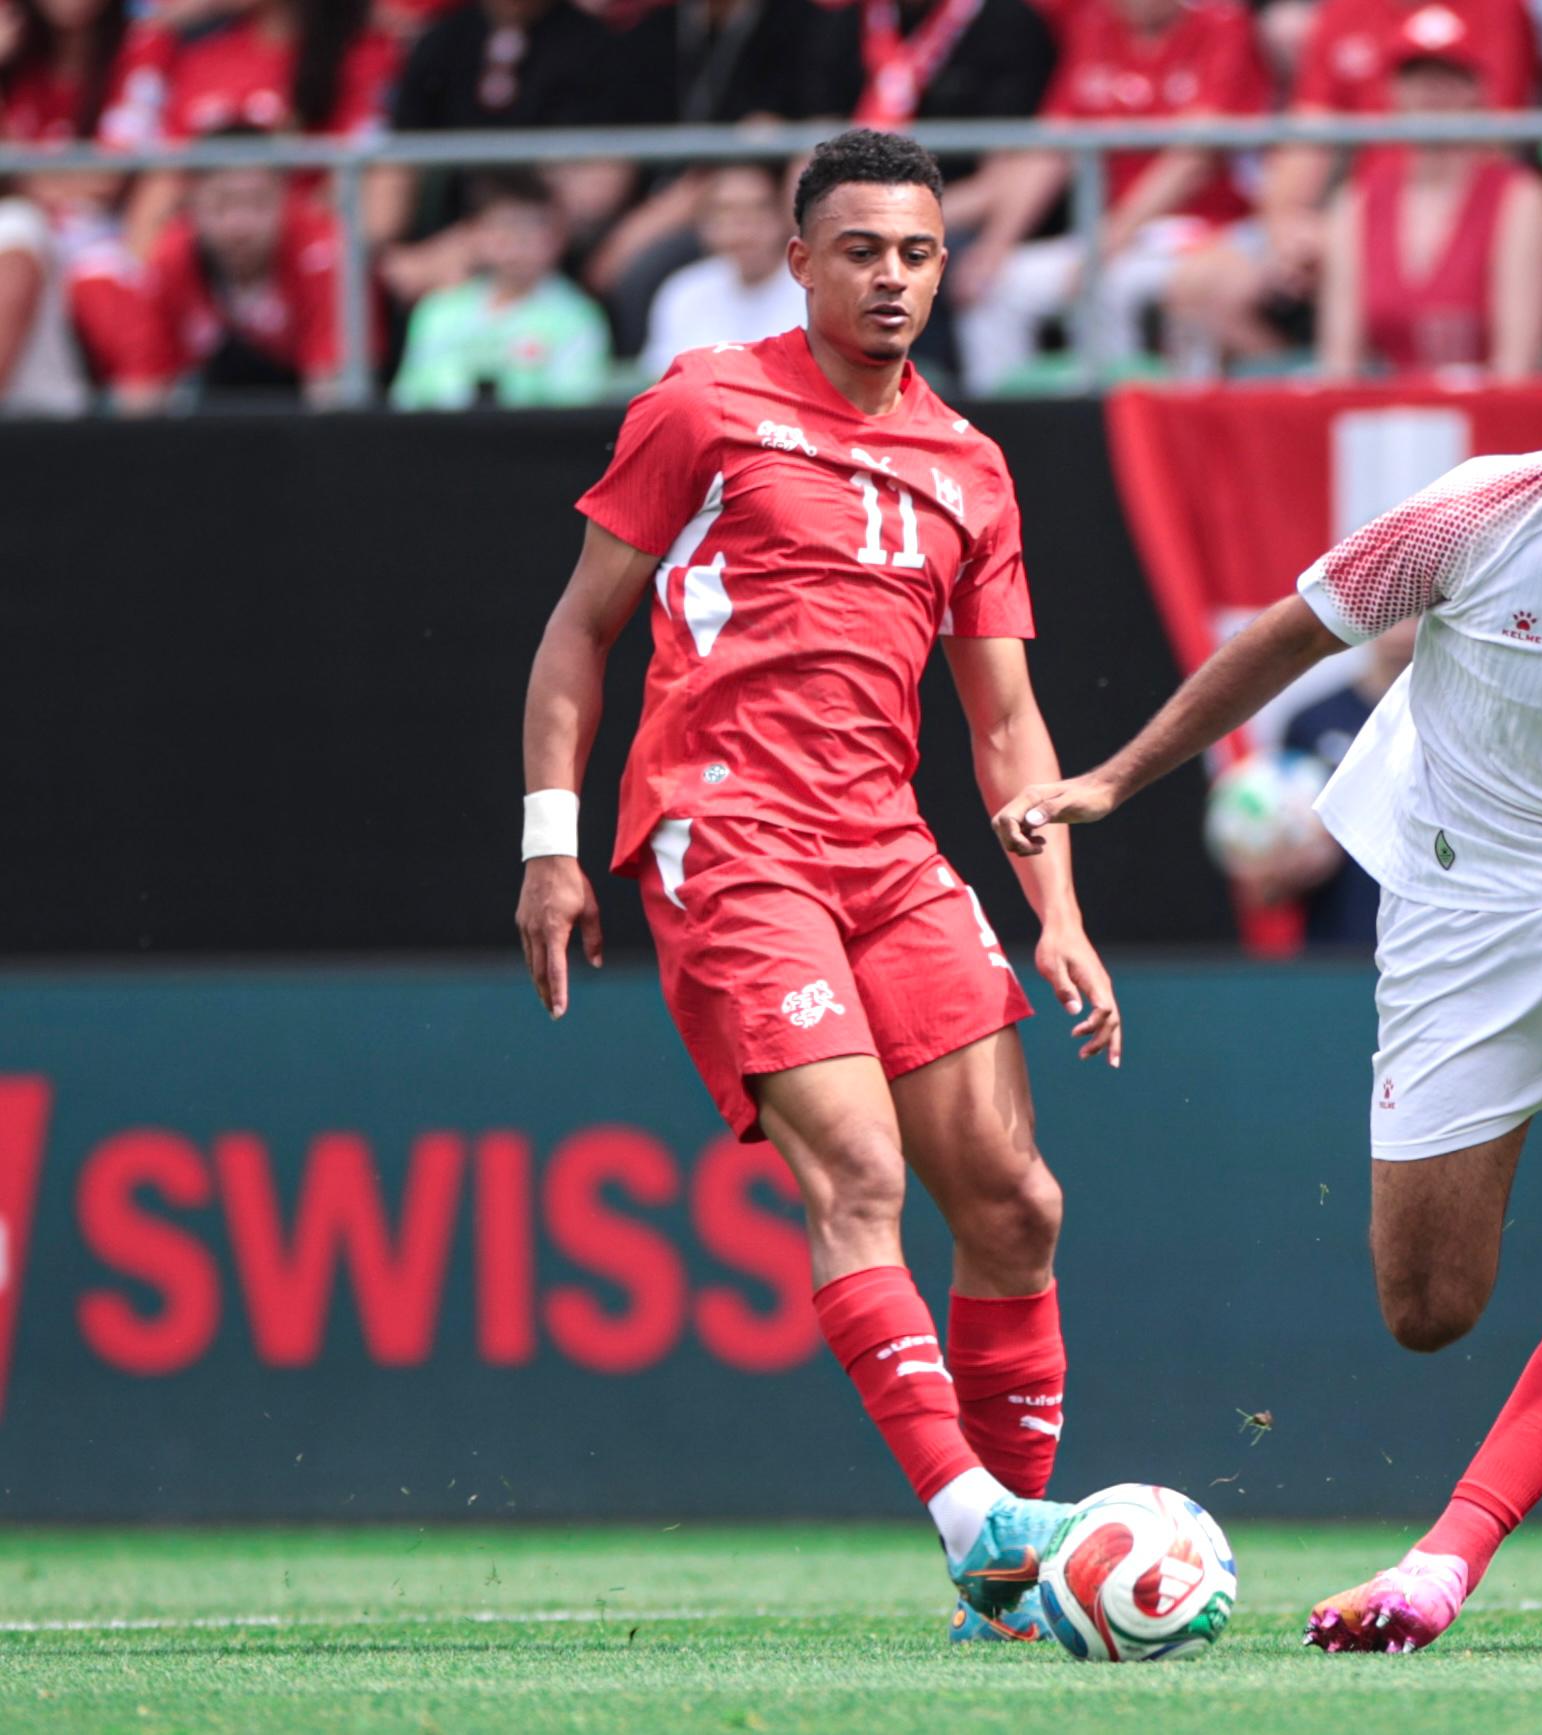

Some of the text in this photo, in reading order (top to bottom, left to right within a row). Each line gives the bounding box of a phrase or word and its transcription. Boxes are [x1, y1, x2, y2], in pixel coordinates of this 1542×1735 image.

[850, 471, 926, 569] 11
[1502, 629, 1542, 644] KELME
[73, 1124, 822, 1374] SWISS
[876, 1334, 938, 1360] suiss
